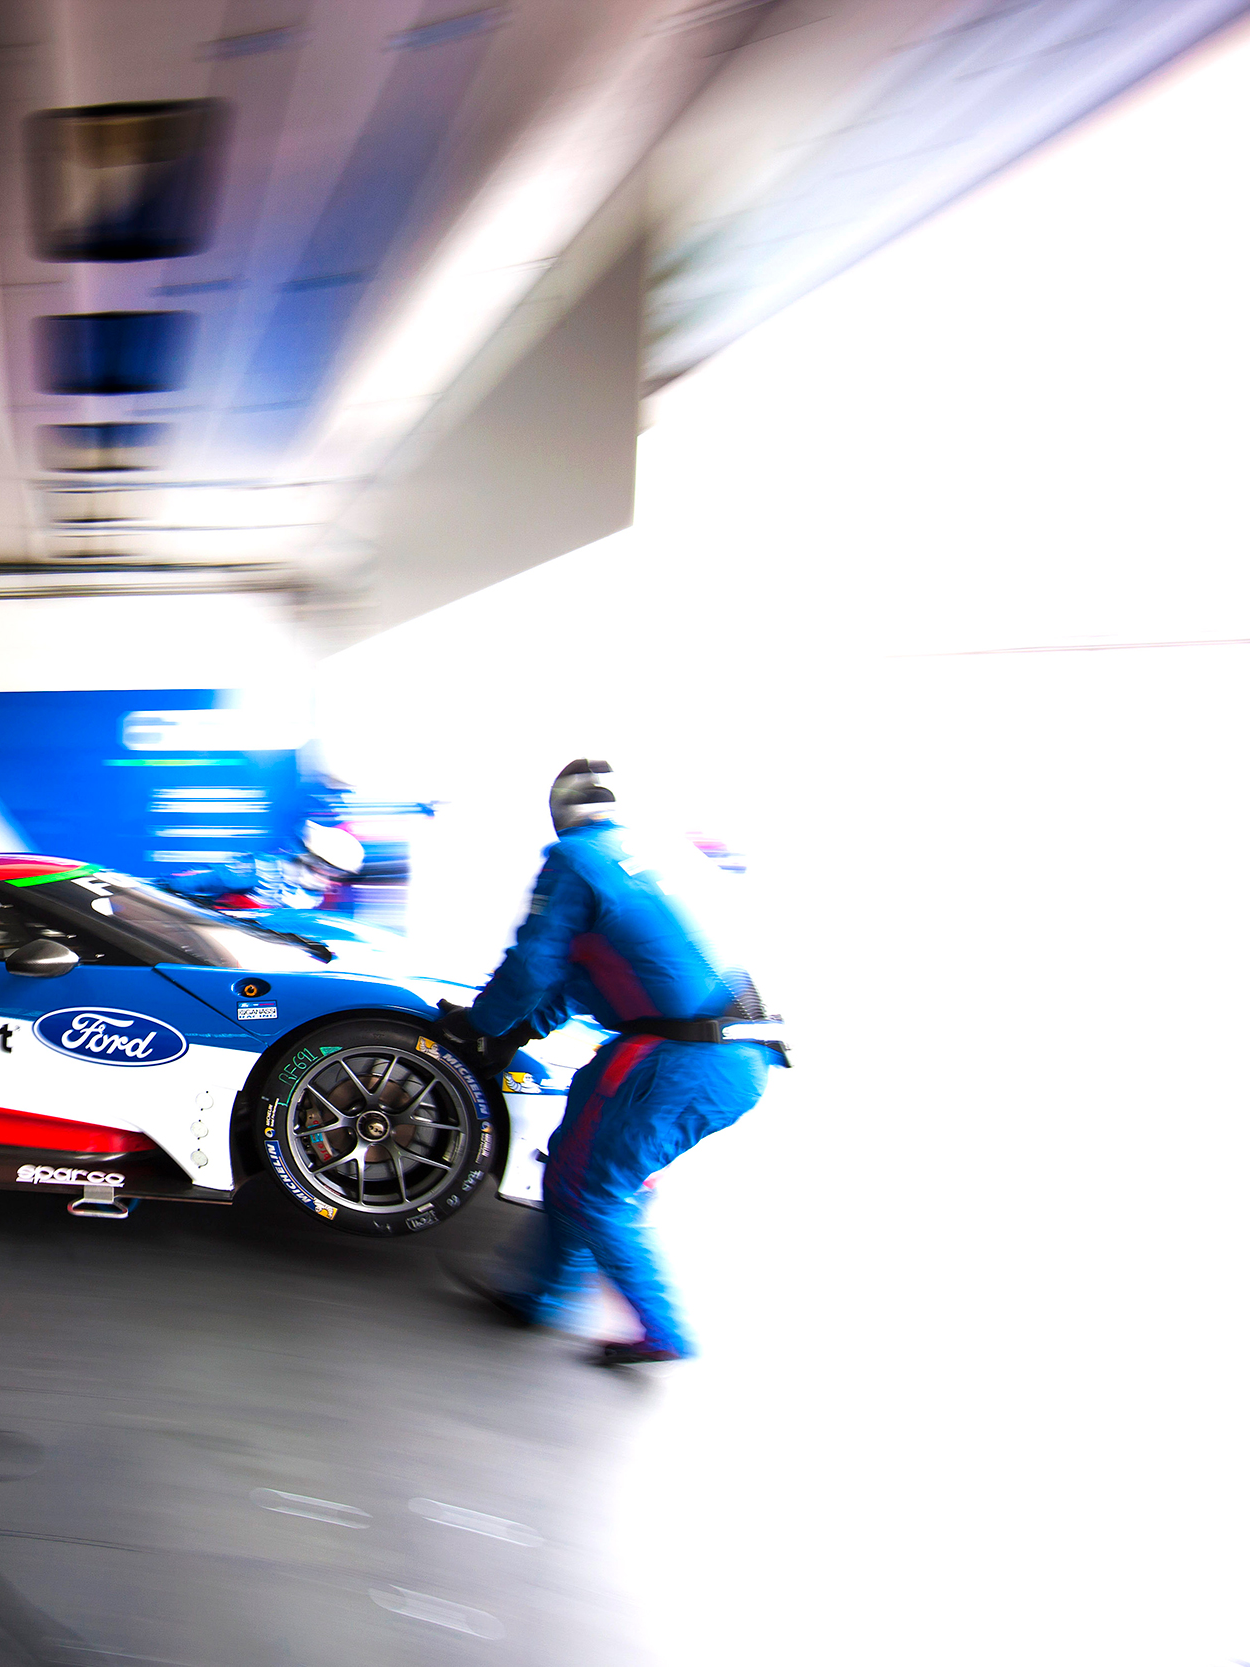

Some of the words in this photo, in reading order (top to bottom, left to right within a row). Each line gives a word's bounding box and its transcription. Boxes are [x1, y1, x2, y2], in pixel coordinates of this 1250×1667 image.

[61, 1013, 157, 1059] Ford
[442, 1052, 489, 1115] MICHELIN
[16, 1164, 126, 1185] sparco
[266, 1143, 312, 1204] MICHELIN
